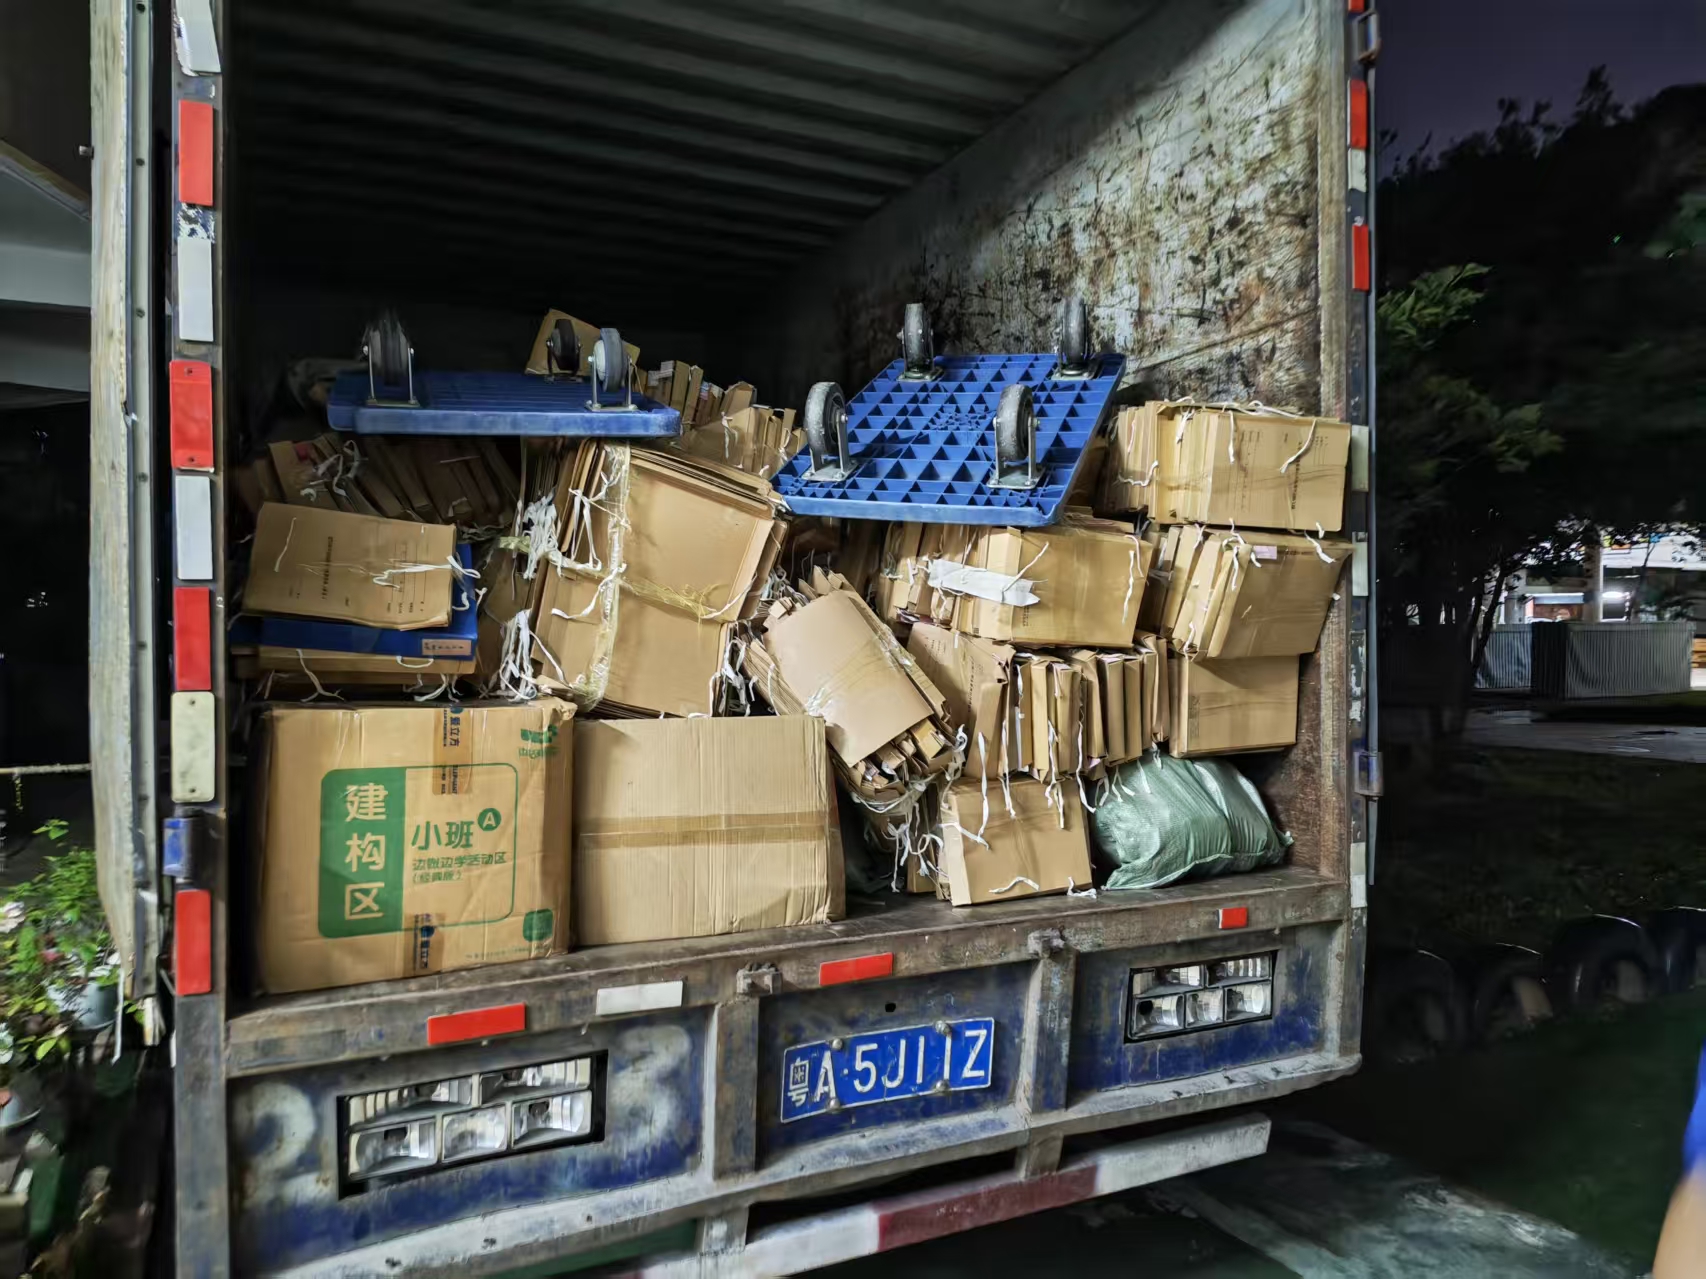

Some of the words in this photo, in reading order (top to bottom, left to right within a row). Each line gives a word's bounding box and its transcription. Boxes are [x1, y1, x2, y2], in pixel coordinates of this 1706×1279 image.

[344, 782, 388, 920] 建构区
[411, 821, 474, 850] 小班
